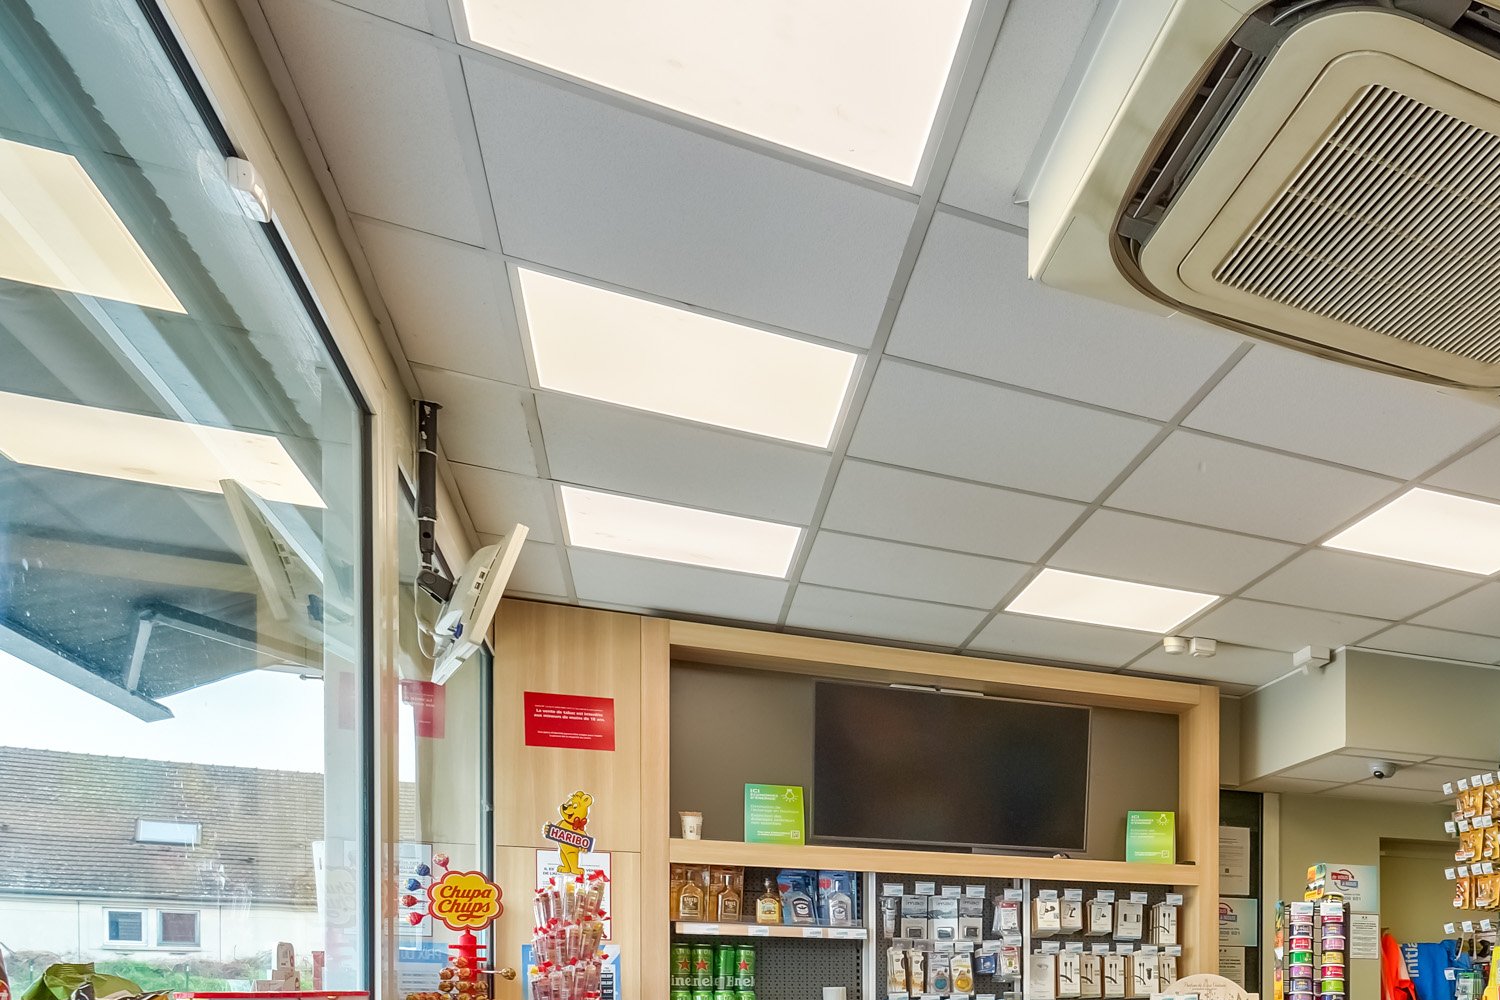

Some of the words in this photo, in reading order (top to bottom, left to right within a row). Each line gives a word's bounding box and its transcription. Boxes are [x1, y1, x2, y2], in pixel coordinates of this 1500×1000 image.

[550, 828, 590, 848] HARIBO
[440, 885, 493, 902] Chupa
[438, 899, 491, 921] Chups
